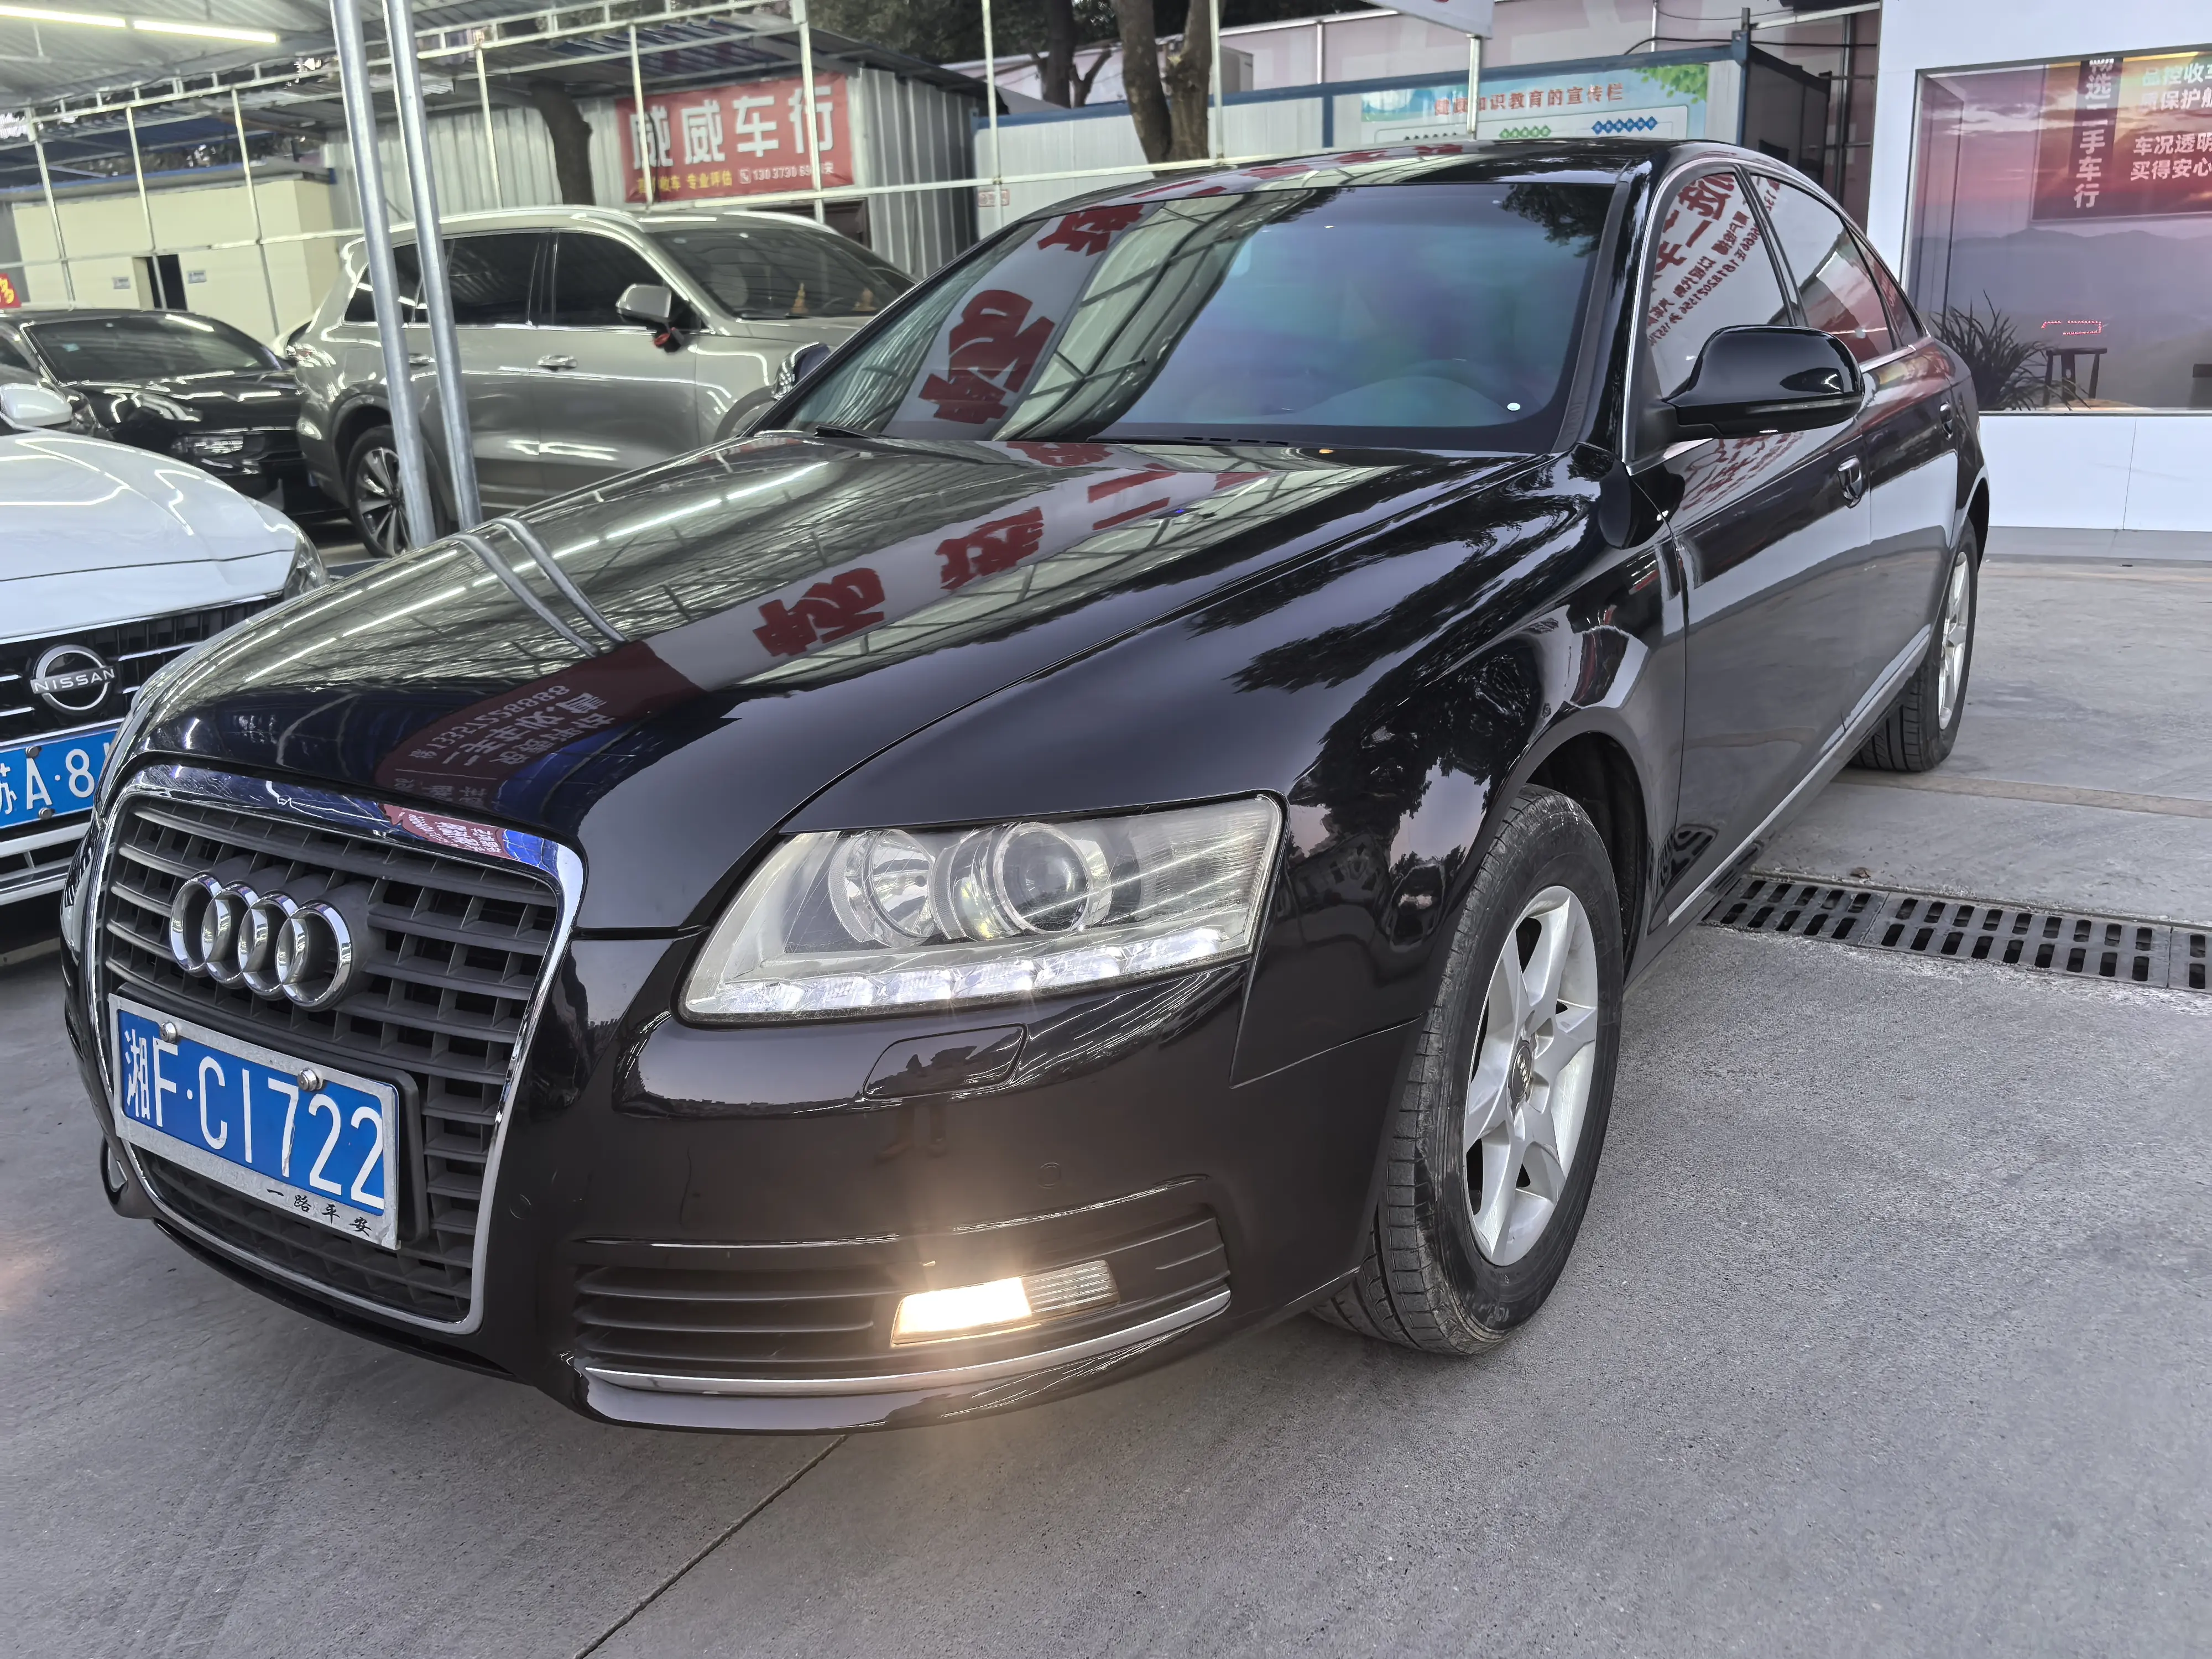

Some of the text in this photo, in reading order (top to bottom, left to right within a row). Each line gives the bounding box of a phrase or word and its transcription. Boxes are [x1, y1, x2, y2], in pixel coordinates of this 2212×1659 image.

[630, 87, 833, 170] 威威车行
[34, 668, 115, 692] NISSAN
[0, 742, 109, 815] A·8
[267, 1188, 372, 1237] 一路平安
